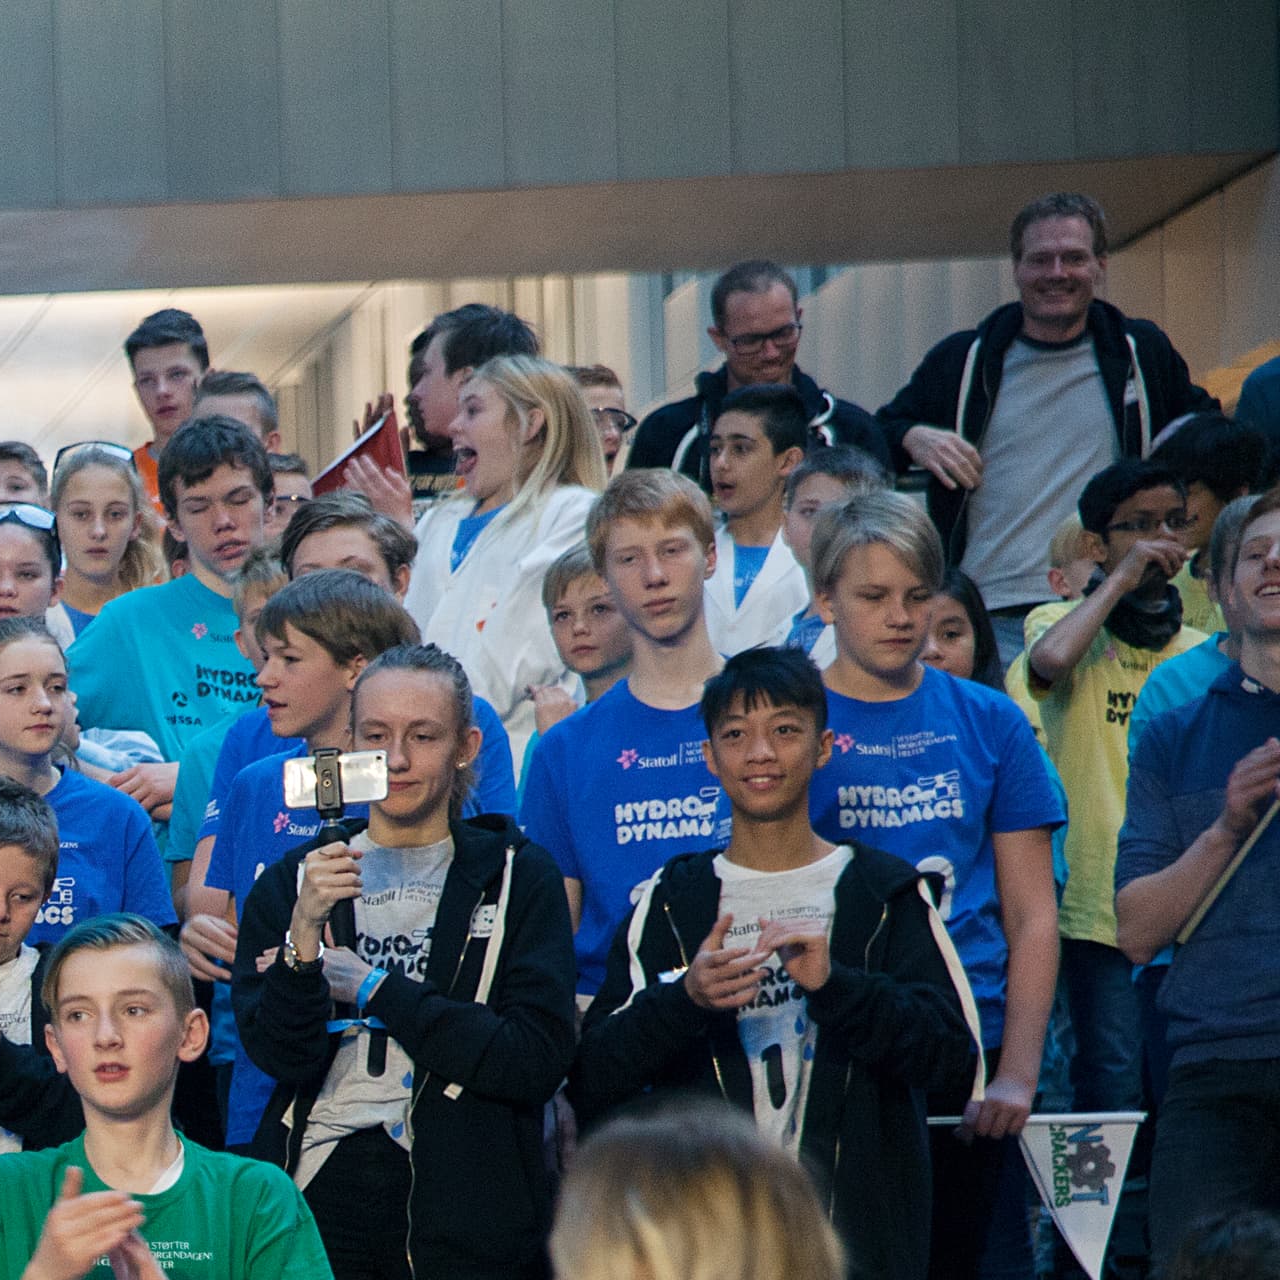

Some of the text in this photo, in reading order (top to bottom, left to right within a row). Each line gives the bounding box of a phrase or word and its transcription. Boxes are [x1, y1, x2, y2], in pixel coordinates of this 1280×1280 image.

[197, 681, 264, 707] DYNAM
[637, 754, 678, 769] Statoil
[837, 785, 921, 808] HYDRO
[615, 795, 702, 825] HYDRO
[838, 798, 964, 829] DYNAMICS
[286, 821, 318, 837] Statoil
[616, 818, 713, 845] DYNAMI
